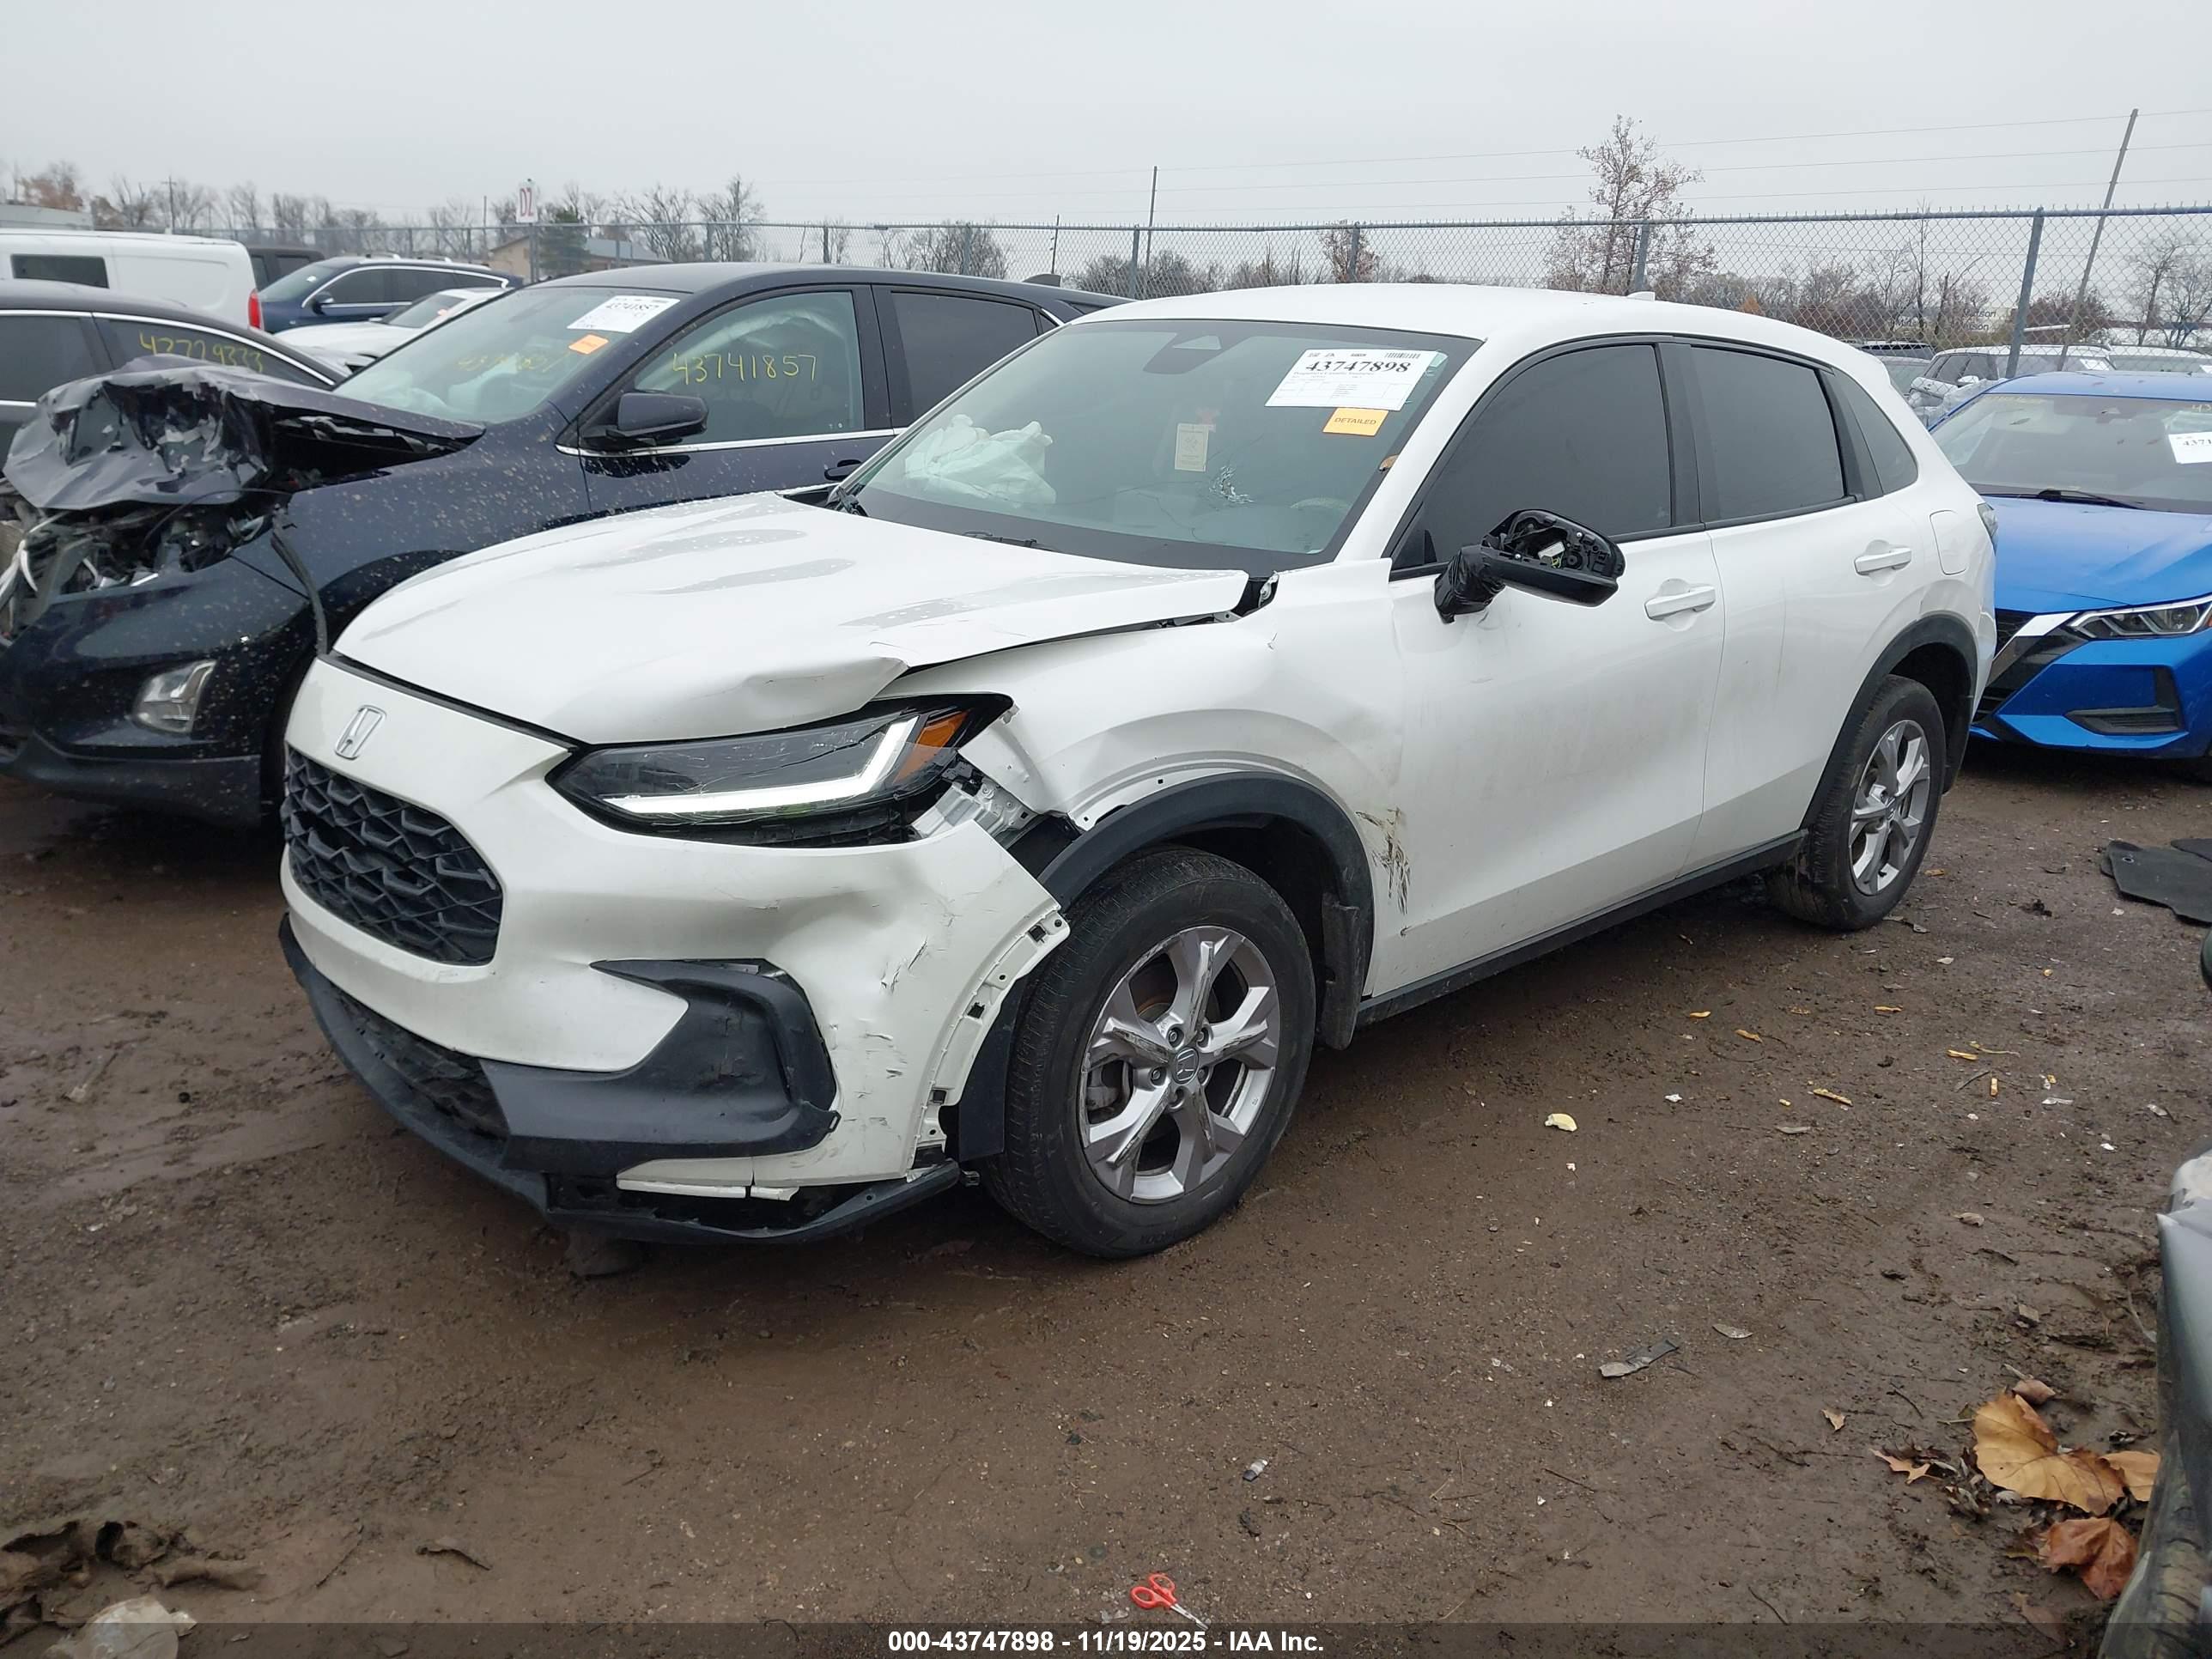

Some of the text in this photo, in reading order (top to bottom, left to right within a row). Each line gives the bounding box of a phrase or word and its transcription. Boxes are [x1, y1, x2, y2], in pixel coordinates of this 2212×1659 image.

[672, 353, 817, 386] 43741857
[1305, 361, 1412, 373] 43747898
[1334, 416, 1377, 426] DETAILED
